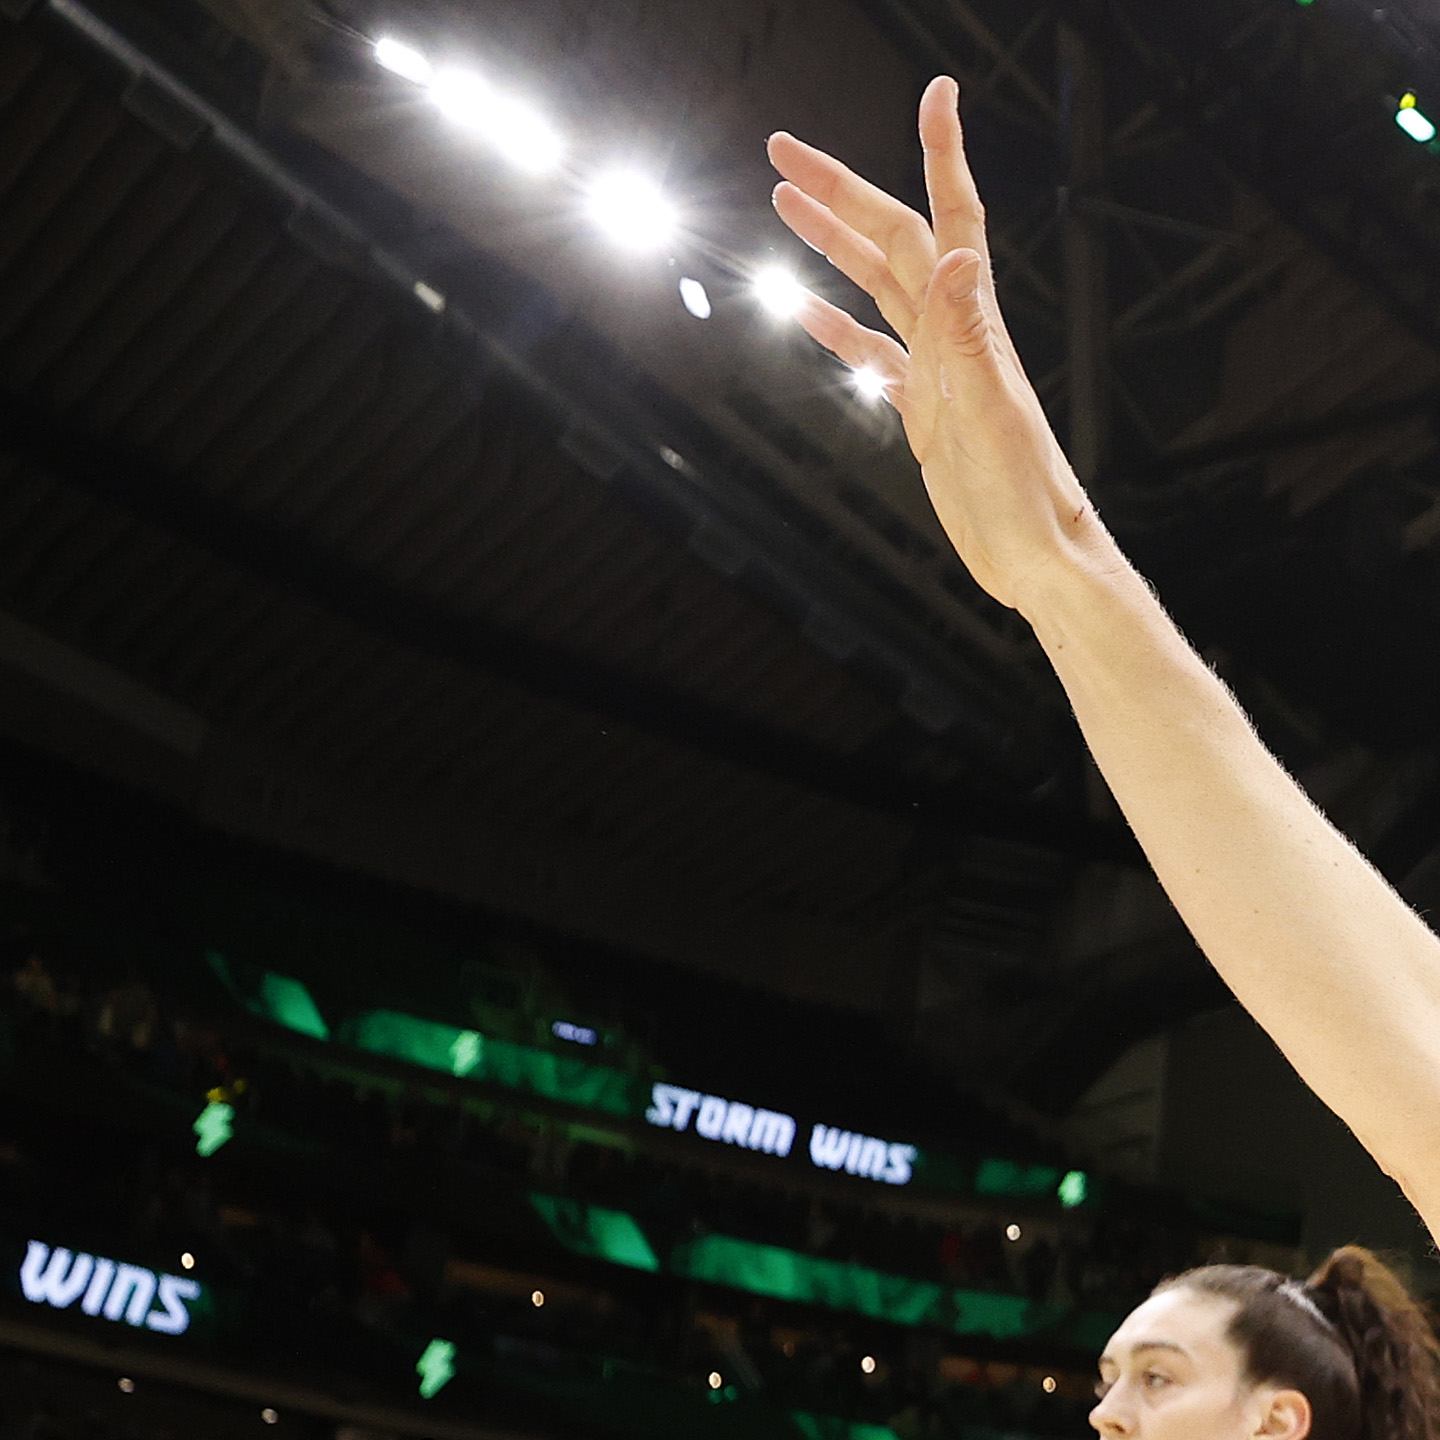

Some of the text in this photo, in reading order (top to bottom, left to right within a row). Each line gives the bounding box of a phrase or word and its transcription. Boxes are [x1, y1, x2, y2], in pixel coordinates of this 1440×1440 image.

[645, 1083, 918, 1186] STORM WINS
[19, 1240, 200, 1334] WINS
